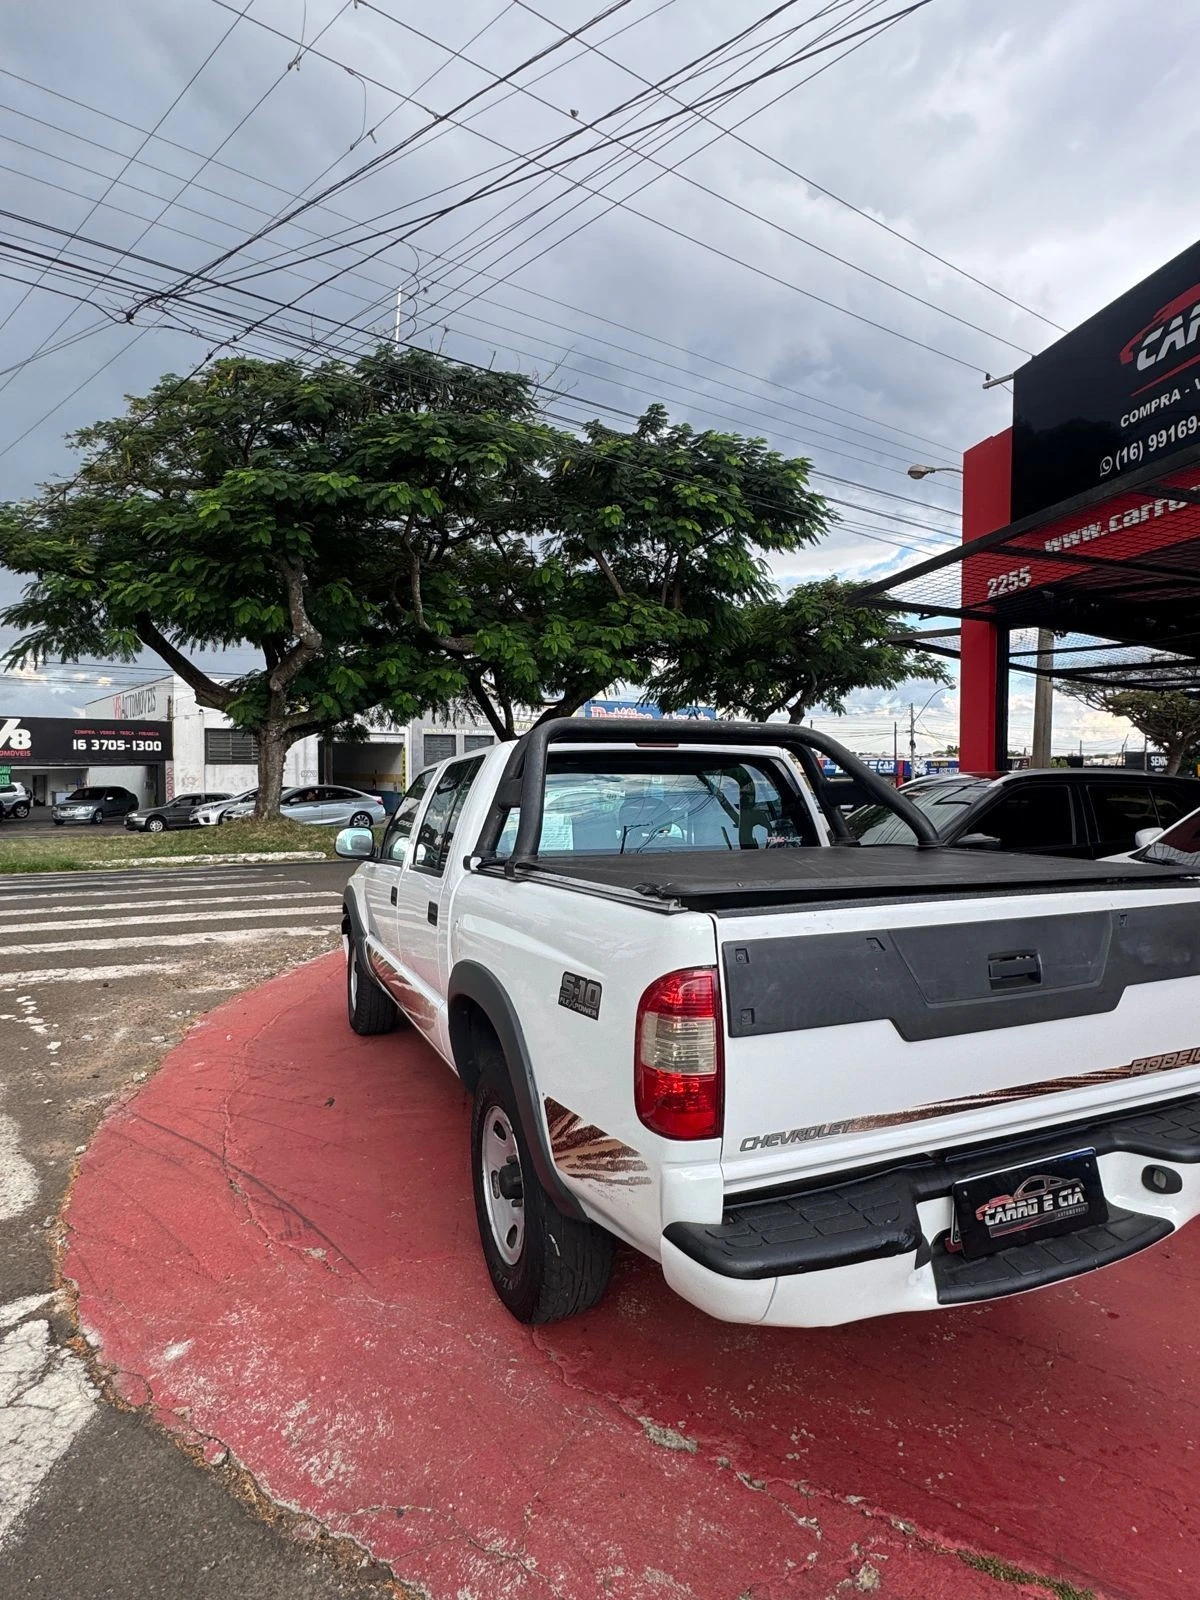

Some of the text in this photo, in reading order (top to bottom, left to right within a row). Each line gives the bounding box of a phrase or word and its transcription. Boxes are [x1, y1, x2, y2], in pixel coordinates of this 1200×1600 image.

[1120, 388, 1181, 428] COMPRA
[1115, 440, 1144, 471] (16)
[987, 565, 1032, 599] 2255
[72, 739, 162, 751] 16 3705-1300
[739, 1119, 854, 1152] CHEVROLET
[984, 1186, 1085, 1226] CARRO E CIA
